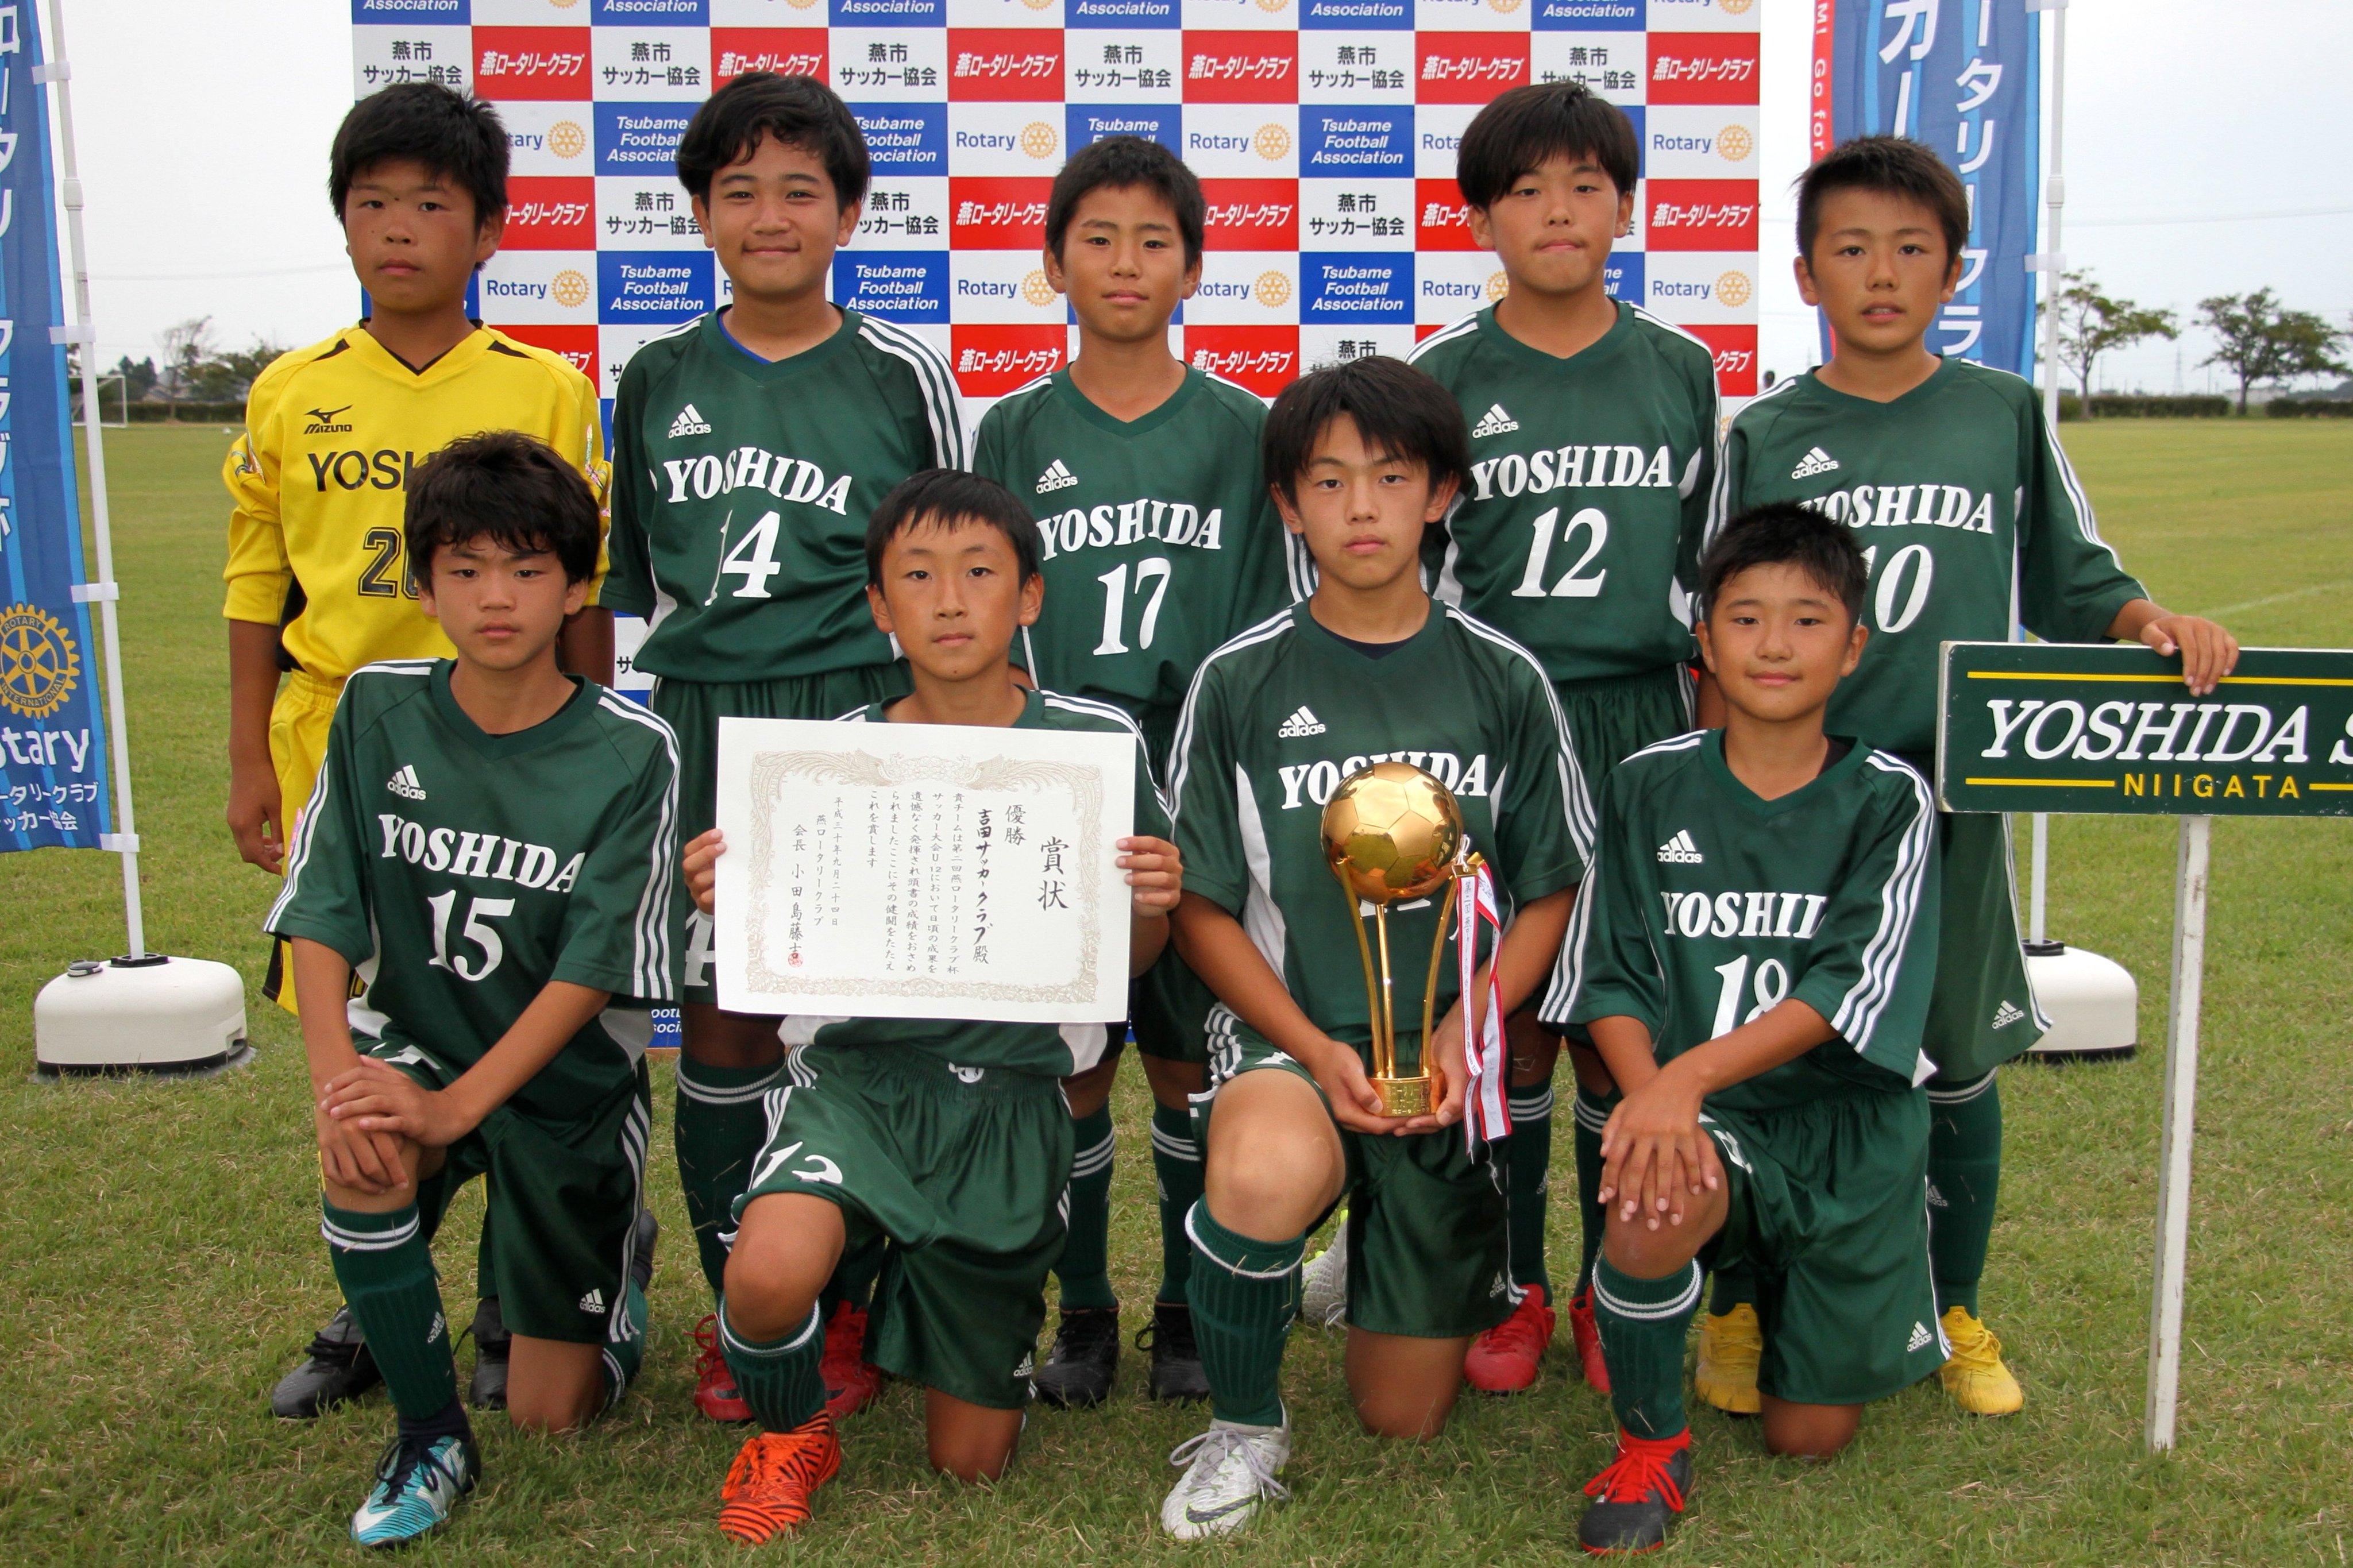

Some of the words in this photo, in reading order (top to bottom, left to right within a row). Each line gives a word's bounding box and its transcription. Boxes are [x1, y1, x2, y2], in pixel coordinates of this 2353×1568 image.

[363, 0, 458, 10] Association
[603, 0, 698, 13] Association
[840, 1, 935, 15] Association
[1076, 2, 1170, 16] Association
[1310, 3, 1403, 17] Association
[1542, 3, 1635, 18] Association
[392, 41, 433, 61] 燕市
[631, 43, 671, 63] 燕市
[868, 44, 908, 63] 燕市
[1103, 45, 1143, 64] 燕市
[1337, 46, 1376, 65] 燕市
[1569, 47, 1608, 67] 燕市
[480, 51, 585, 77] 燕ロータリークラブ
[718, 52, 823, 78] 燕ロータリークラブ
[954, 53, 1059, 78] 燕ロータリークラブ
[1189, 55, 1292, 80] 燕ロータリークラブ
[1422, 55, 1525, 81] 燕ロータリークラブ
[1653, 56, 1756, 82] 燕ロータリークラブ
[364, 65, 462, 84] サッカー協会
[603, 67, 701, 87] サッカー協会
[839, 68, 938, 88] サッカー協会
[1075, 69, 1172, 89] サッカー協会
[1309, 70, 1405, 90] サッカー協会
[1814, 59, 1826, 97] Go
[616, 117, 688, 130] Tsubame
[854, 117, 924, 131] Tsubame
[1087, 118, 1159, 132] Tsubame
[1321, 119, 1392, 133] Tsubame
[1813, 110, 1826, 150] for
[507, 132, 543, 150] tary
[955, 132, 1016, 151] Rotary
[1190, 133, 1249, 153] Rotary
[1325, 135, 1388, 149] Football
[1422, 133, 1461, 150] Rota
[1653, 134, 1712, 154] Rotary
[607, 149, 677, 163] Associat
[869, 149, 936, 163] sociation
[1311, 150, 1403, 165] Association
[634, 192, 674, 212] 燕市
[870, 192, 910, 212] 燕市
[1337, 194, 1376, 213] 燕市
[956, 202, 1048, 227] 燕ロータリークラ
[1205, 204, 1293, 228] ロータリークラブ
[1652, 203, 1754, 228] 燕ロータリークラブ
[859, 216, 939, 236] ッカー協会
[1309, 217, 1405, 237] サッカー協会
[620, 265, 692, 279] Tsubame
[855, 265, 927, 279] Tsubame
[1321, 266, 1392, 280] Tsubame
[487, 280, 547, 299] Rotary
[624, 281, 688, 295] Football
[859, 281, 924, 295] Football
[958, 280, 1017, 299] Rotary
[1325, 282, 1388, 296] Football
[1422, 280, 1481, 300] Rotary
[1652, 280, 1711, 299] Rotary
[610, 297, 704, 311] Association
[846, 296, 939, 311] Association
[1311, 298, 1403, 312] Association
[1337, 339, 1377, 359] 燕市
[958, 349, 1062, 373] 燕ロータリークラブ
[1191, 349, 1294, 374] 燕ロータリークラブ
[668, 422, 712, 439] adidas
[1472, 420, 1519, 439] adidas
[1469, 446, 1672, 501] YOSHIDA
[1791, 459, 1839, 480] adidas
[663, 447, 853, 516] YOSHIDA
[1036, 476, 1078, 495] adidas
[1036, 498, 1222, 561] YOSHIDA
[1511, 507, 1608, 597] 12
[1093, 557, 1171, 656] 17
[4, 615, 42, 631] ROTARY
[1, 677, 65, 707] INTERNATIONAL
[1278, 723, 1326, 739] adidas
[1980, 699, 2309, 763] YOSHIDA
[387, 779, 427, 801] adidas
[2124, 773, 2300, 799] NIIGATA
[866, 790, 880, 868] これを賞します
[1004, 804, 1027, 847] 優勝
[792, 824, 808, 852] 会長
[378, 814, 586, 893] YOSHIDA
[831, 797, 844, 926] 平成三十年九月二十四日
[1657, 849, 1703, 864] adidas
[813, 814, 827, 926] 燕ロータリークラブ
[1037, 836, 1070, 912] 賞状
[973, 808, 994, 965] 吉田サッカークラブ殿
[427, 889, 516, 982] 15
[1992, 1009, 2024, 1030] adidas
[1907, 1333, 1932, 1352] adidas
